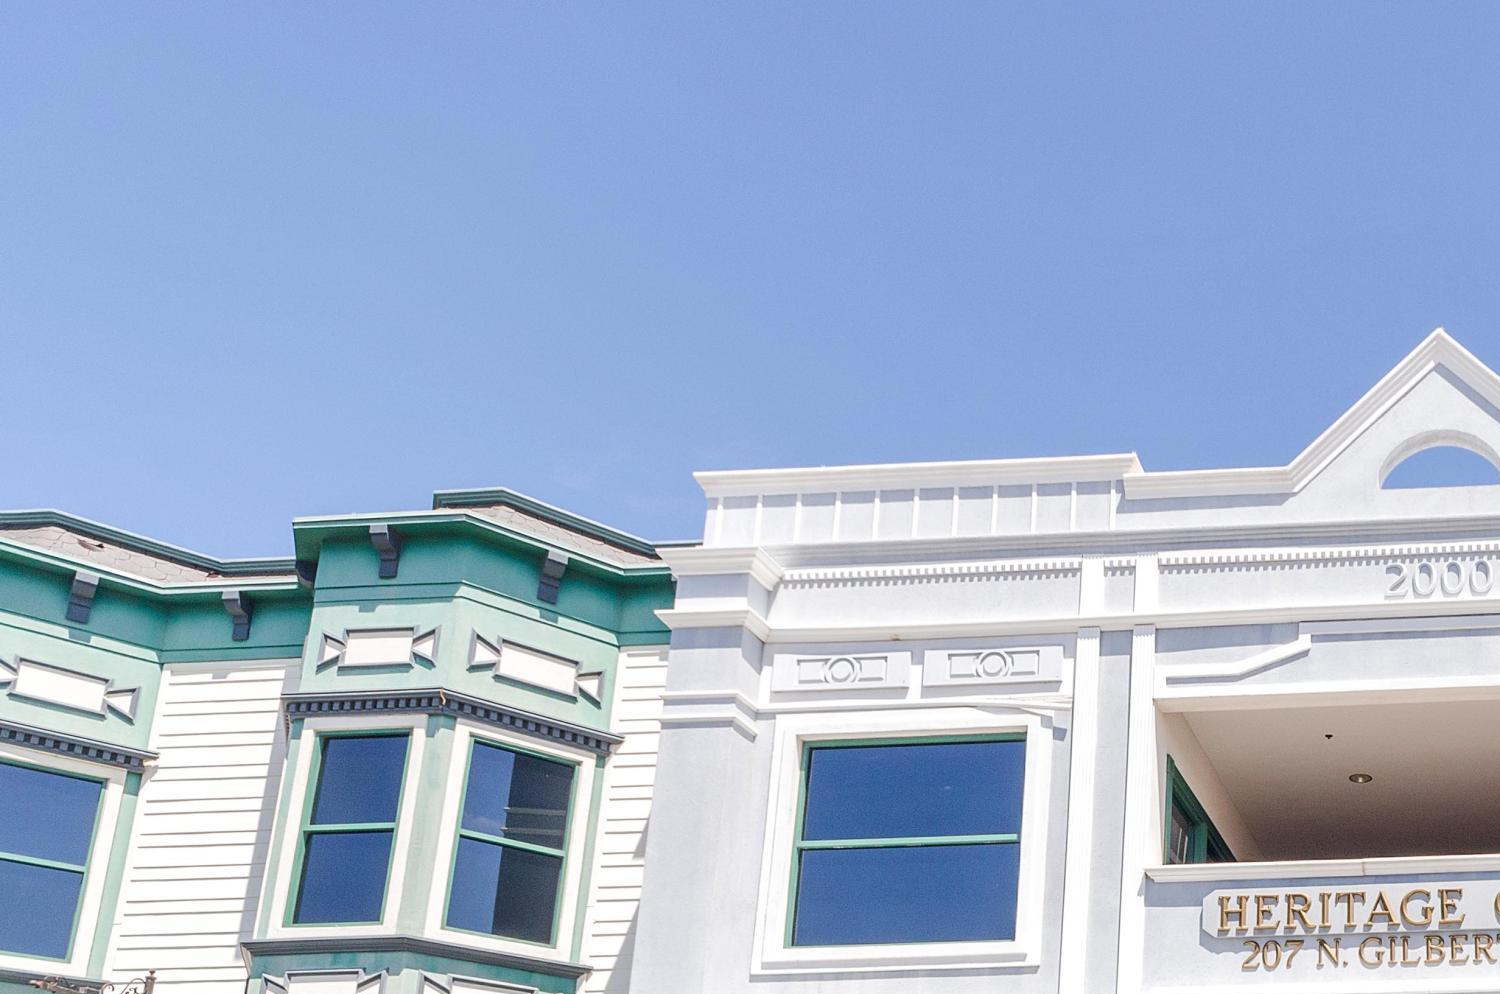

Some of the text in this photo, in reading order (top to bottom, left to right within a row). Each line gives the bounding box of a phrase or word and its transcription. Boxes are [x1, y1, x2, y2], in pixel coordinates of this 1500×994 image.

[1384, 559, 1495, 600] 2000
[1217, 887, 1466, 935] HERITAGE
[1241, 938, 1305, 971] 207
[1316, 937, 1349, 968] N.
